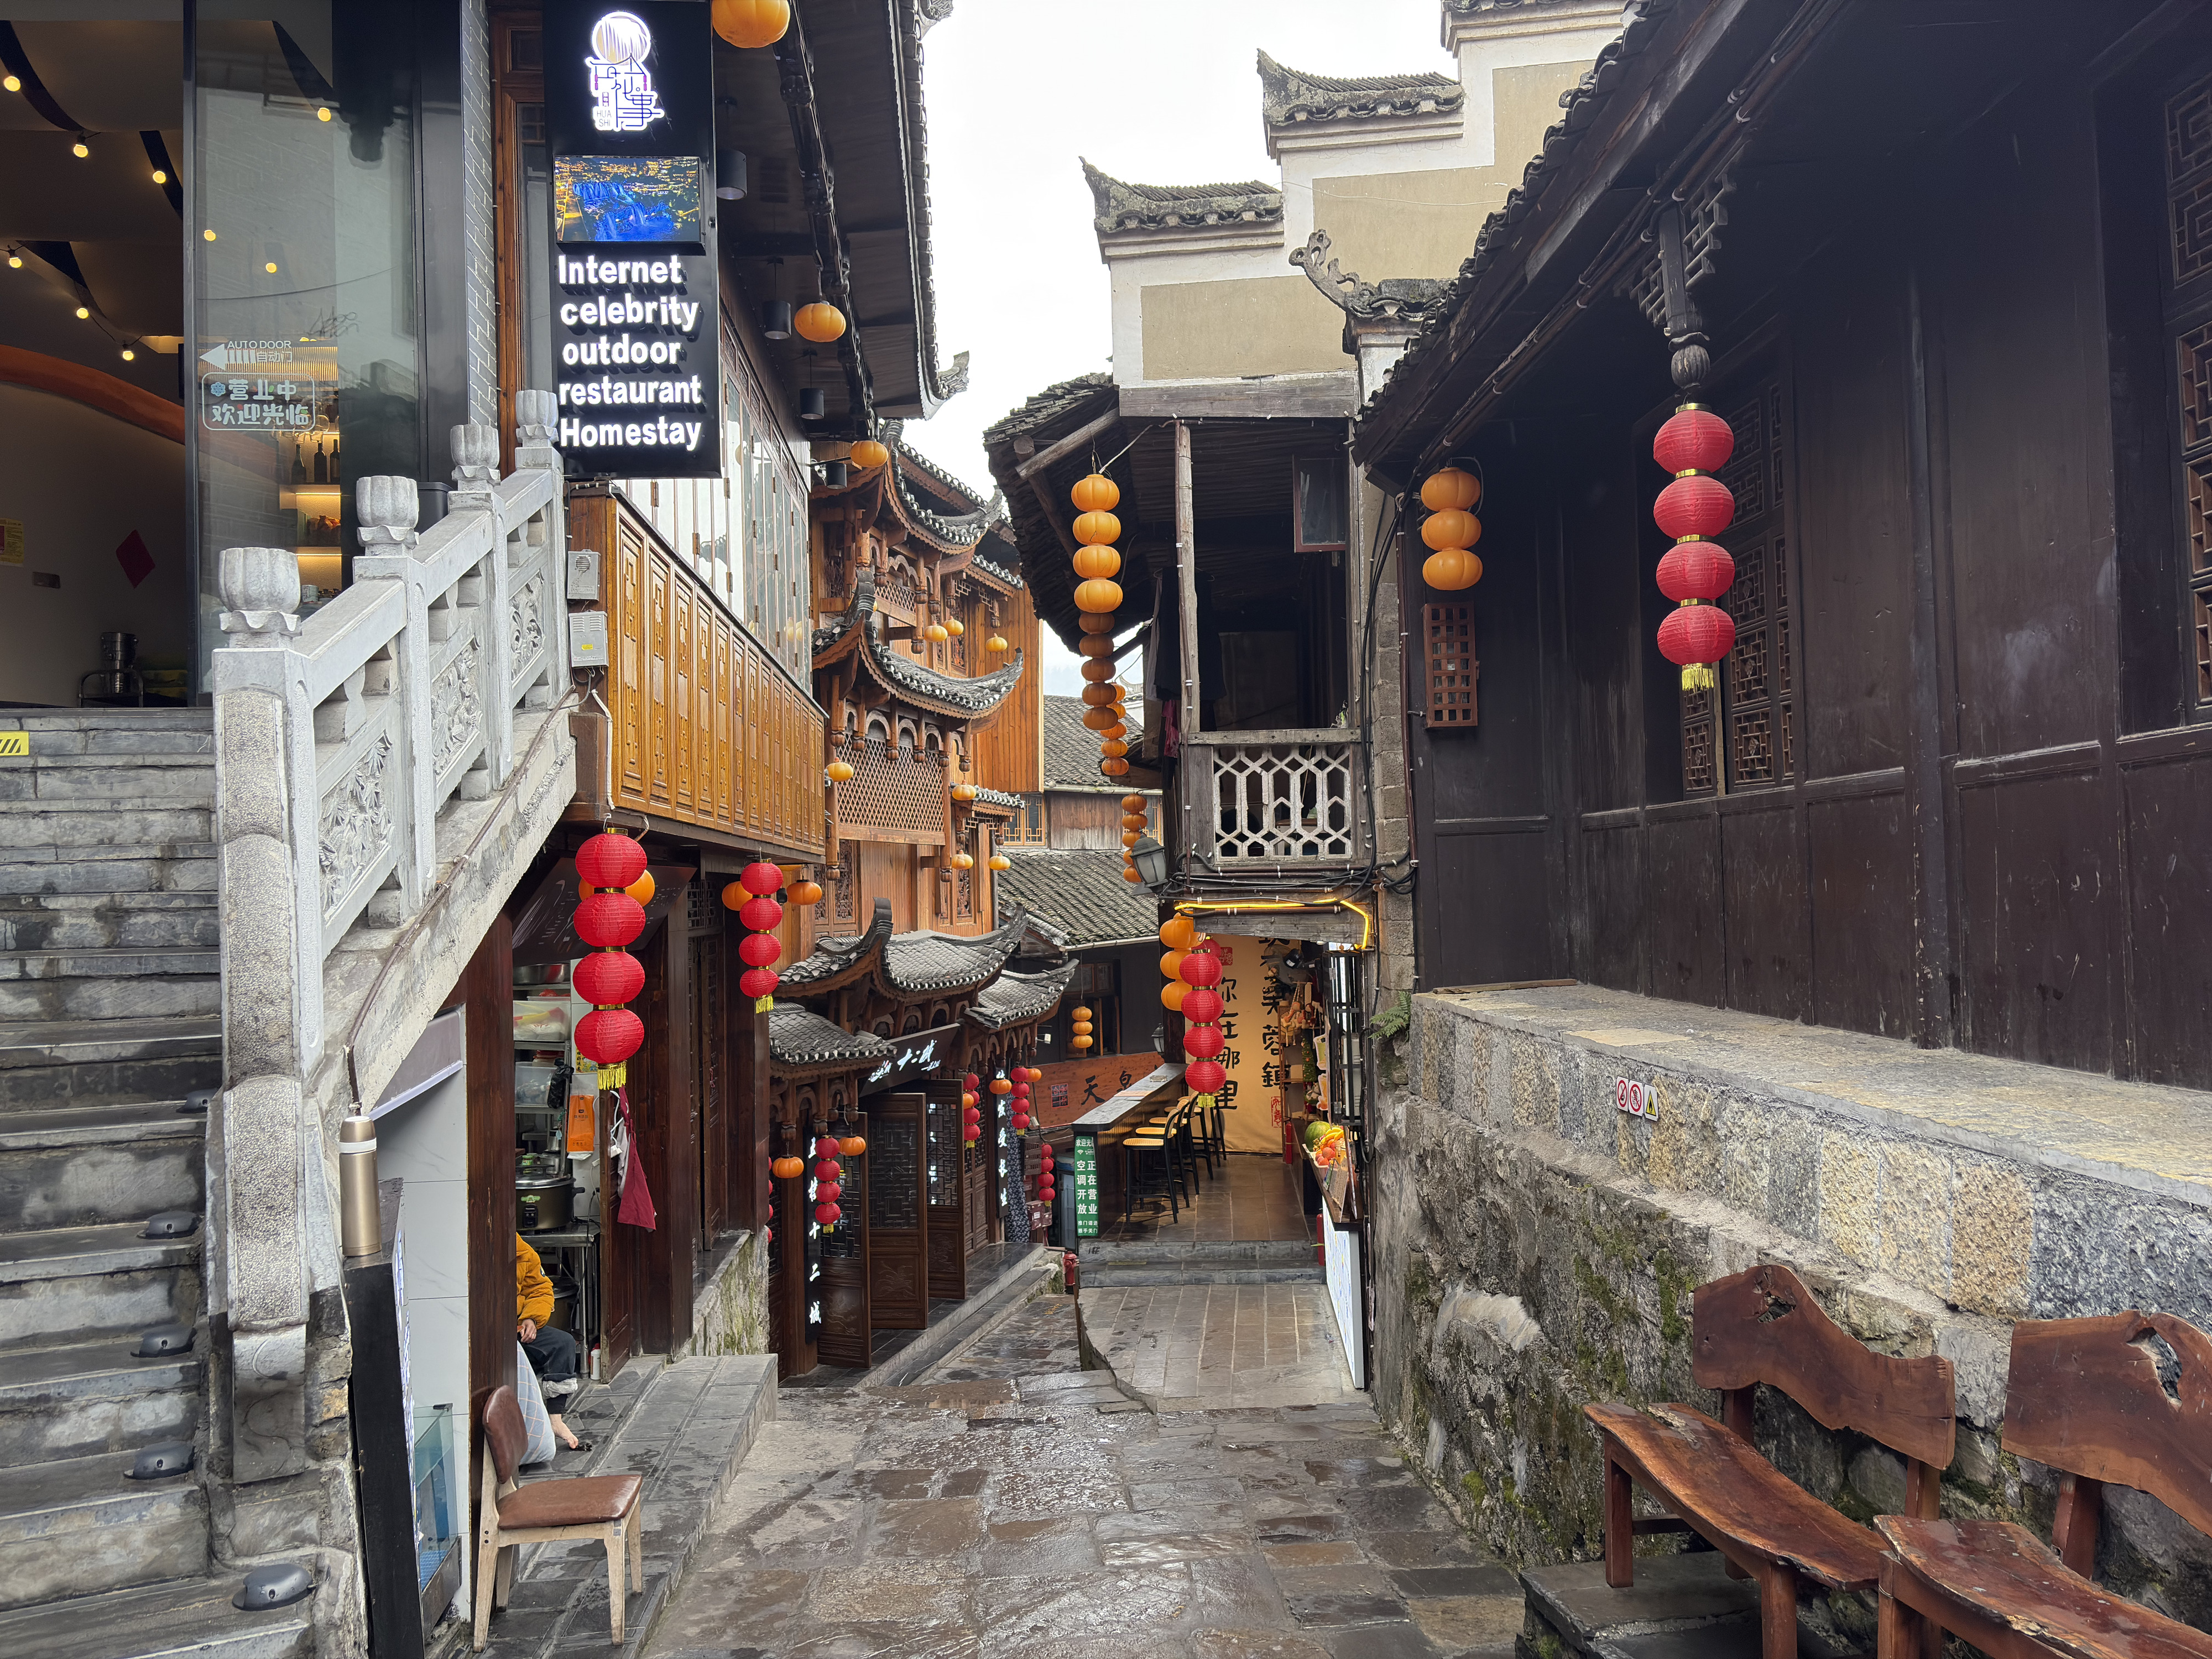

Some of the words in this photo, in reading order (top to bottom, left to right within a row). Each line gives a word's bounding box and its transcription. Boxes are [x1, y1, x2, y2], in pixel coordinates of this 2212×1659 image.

[599, 118, 611, 127] SHI
[557, 254, 682, 284] Internet
[560, 293, 700, 332] celebrity
[227, 341, 257, 349] AUTO
[259, 341, 291, 349] DOOR
[256, 351, 293, 363] 自动门
[562, 333, 681, 365] outdoor
[228, 379, 297, 401] 营业中
[559, 374, 702, 405] restaurant
[212, 403, 309, 425] 欢迎光临
[560, 416, 702, 451] Homestay
[1076, 1139, 1094, 1147] 欢迎光
[1077, 1160, 1087, 1214] 空调开放
[1087, 1160, 1098, 1214] 正在营业
